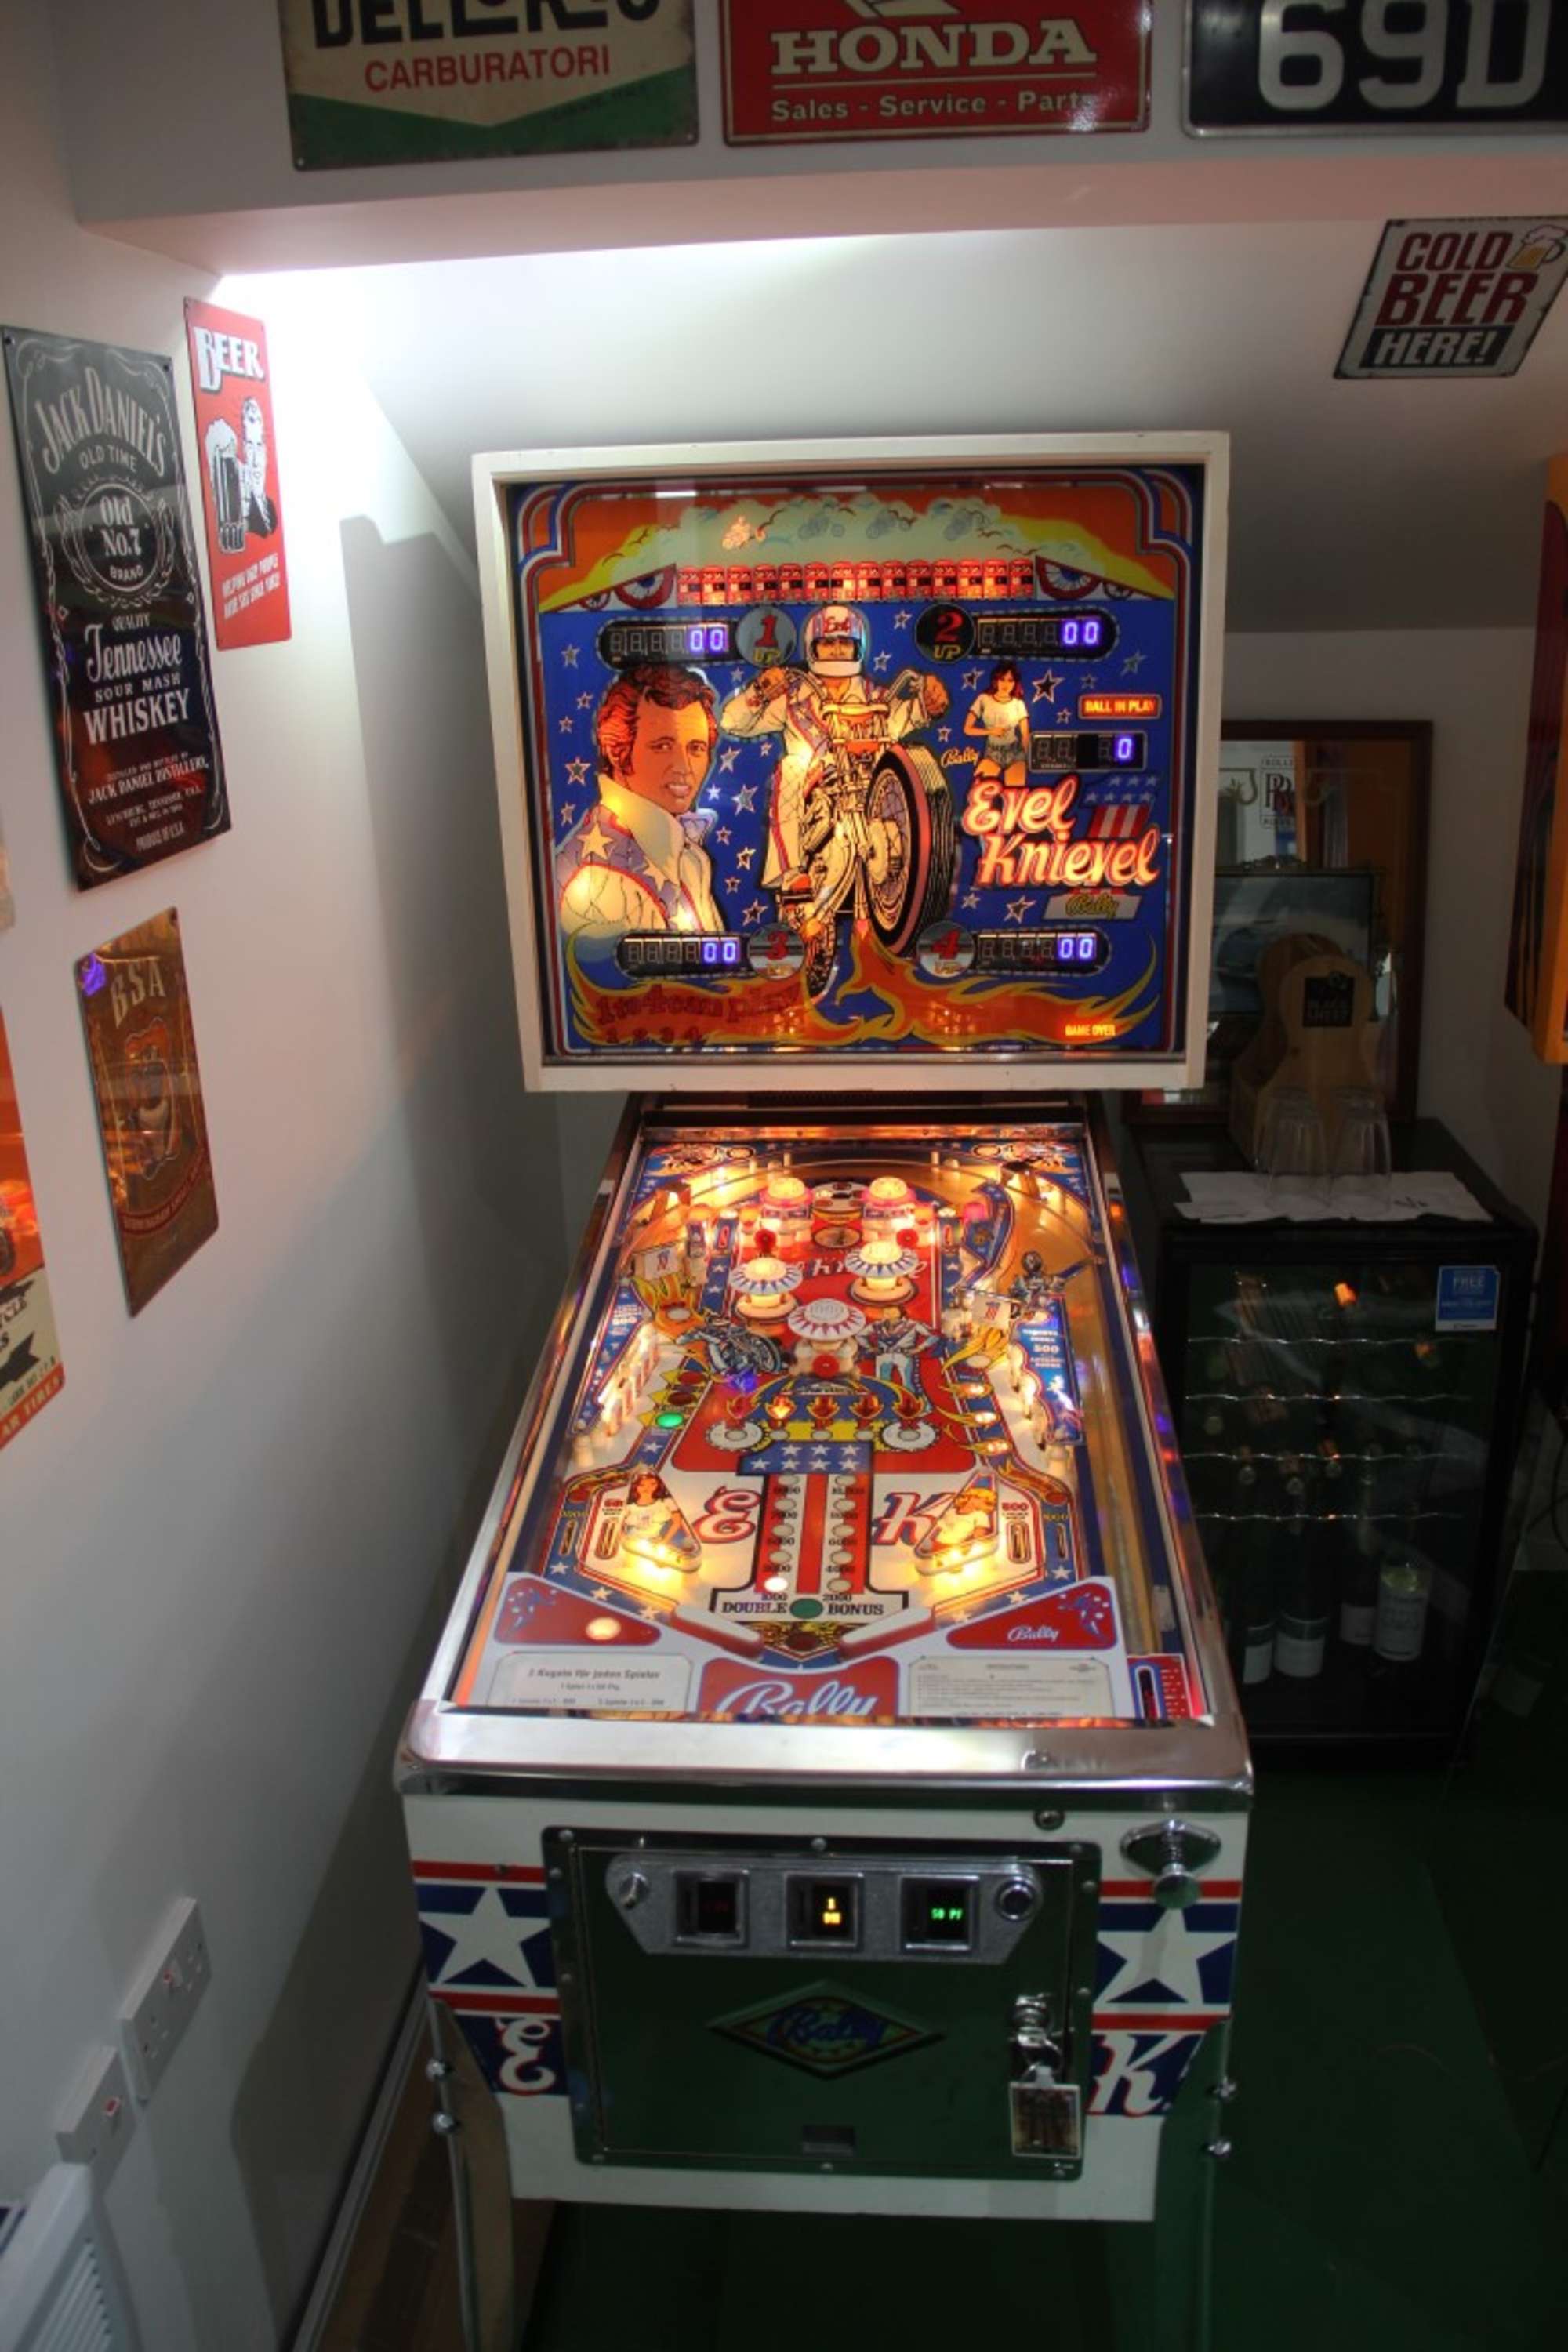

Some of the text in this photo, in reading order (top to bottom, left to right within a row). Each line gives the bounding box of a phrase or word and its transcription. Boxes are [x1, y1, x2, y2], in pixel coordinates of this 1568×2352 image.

[771, 19, 1097, 75] HONDA
[365, 45, 611, 92] CARBURATORI
[771, 99, 848, 121] Sales
[880, 92, 986, 117] Service
[1396, 232, 1514, 272] COLD
[1374, 272, 1539, 327] BEER
[193, 325, 266, 392] BEER
[1373, 330, 1499, 366] HERE!
[35, 366, 167, 477] JACK DANIEL'S
[80, 445, 138, 471] OLD TIME
[100, 495, 135, 526] Old
[110, 564, 144, 580] BRAND
[755, 615, 779, 647] 1
[934, 610, 964, 643] 2
[84, 624, 183, 683] Tennessee
[933, 644, 961, 659] UP
[95, 671, 181, 704] SOUR MASH
[82, 688, 191, 745] WHISKEY
[88, 783, 118, 805] JACK
[118, 772, 154, 796] DANIEL
[963, 775, 1080, 836] Evel
[977, 823, 1161, 888] Knievel
[765, 930, 789, 960] 3
[931, 928, 961, 960] 4
[110, 957, 167, 1027] BSA
[1092, 1024, 1116, 1036] OVER
[691, 1486, 761, 1544] E
[721, 1602, 884, 1616] DOUBLE BONUS
[1007, 1624, 1060, 1642] Bally
[537, 1668, 573, 1679] Kugeln
[593, 1668, 622, 1679] jeden
[624, 1669, 661, 1679] Spieler
[715, 1679, 878, 1715] Bally
[495, 2017, 556, 2096] E
[1087, 2033, 1200, 2118] K
